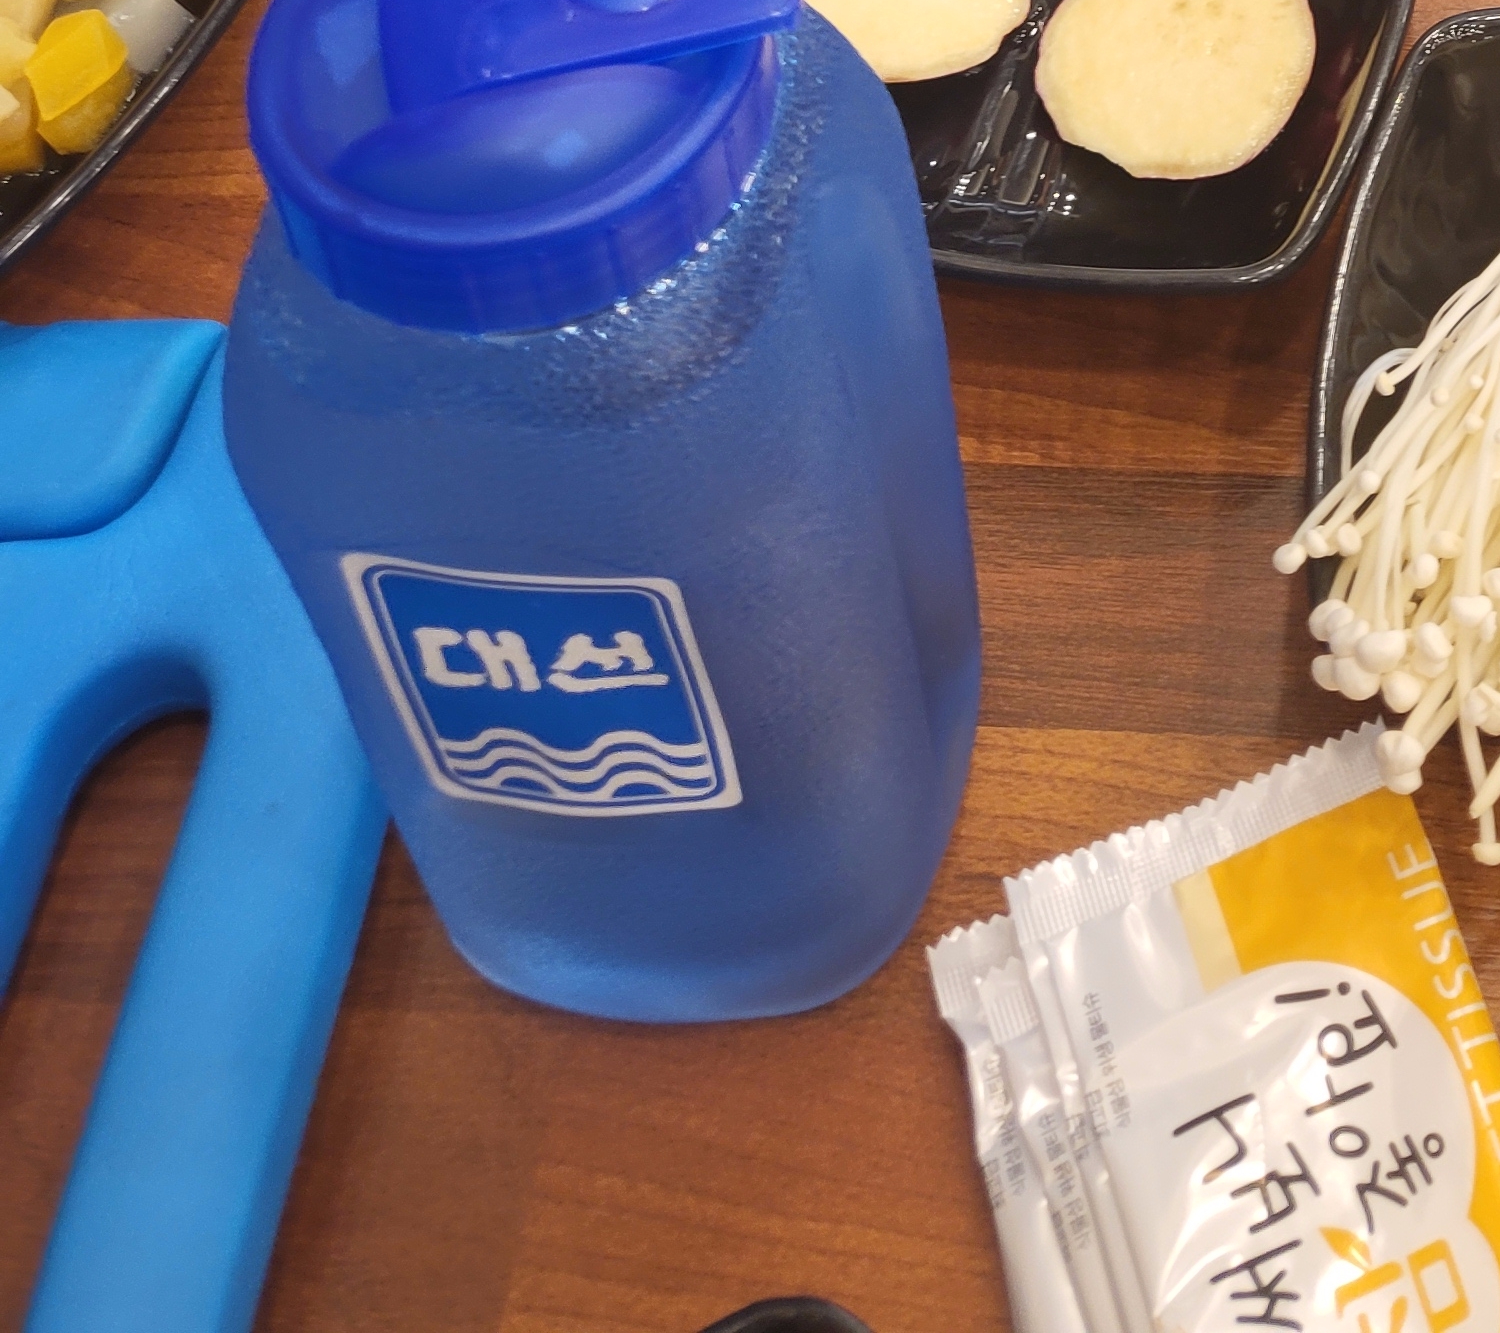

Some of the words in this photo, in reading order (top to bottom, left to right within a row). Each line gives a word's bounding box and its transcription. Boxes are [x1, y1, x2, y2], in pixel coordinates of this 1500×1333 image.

[413, 627, 670, 693] 대선
[1387, 842, 1498, 1070] TISSUE
[1083, 992, 1109, 1041] 물티슈
[1095, 1040, 1118, 1076] 위생
[1105, 1077, 1132, 1129] 식물성
[1274, 981, 1444, 1235] 좋아요!
[1172, 1092, 1320, 1333] 써보니
